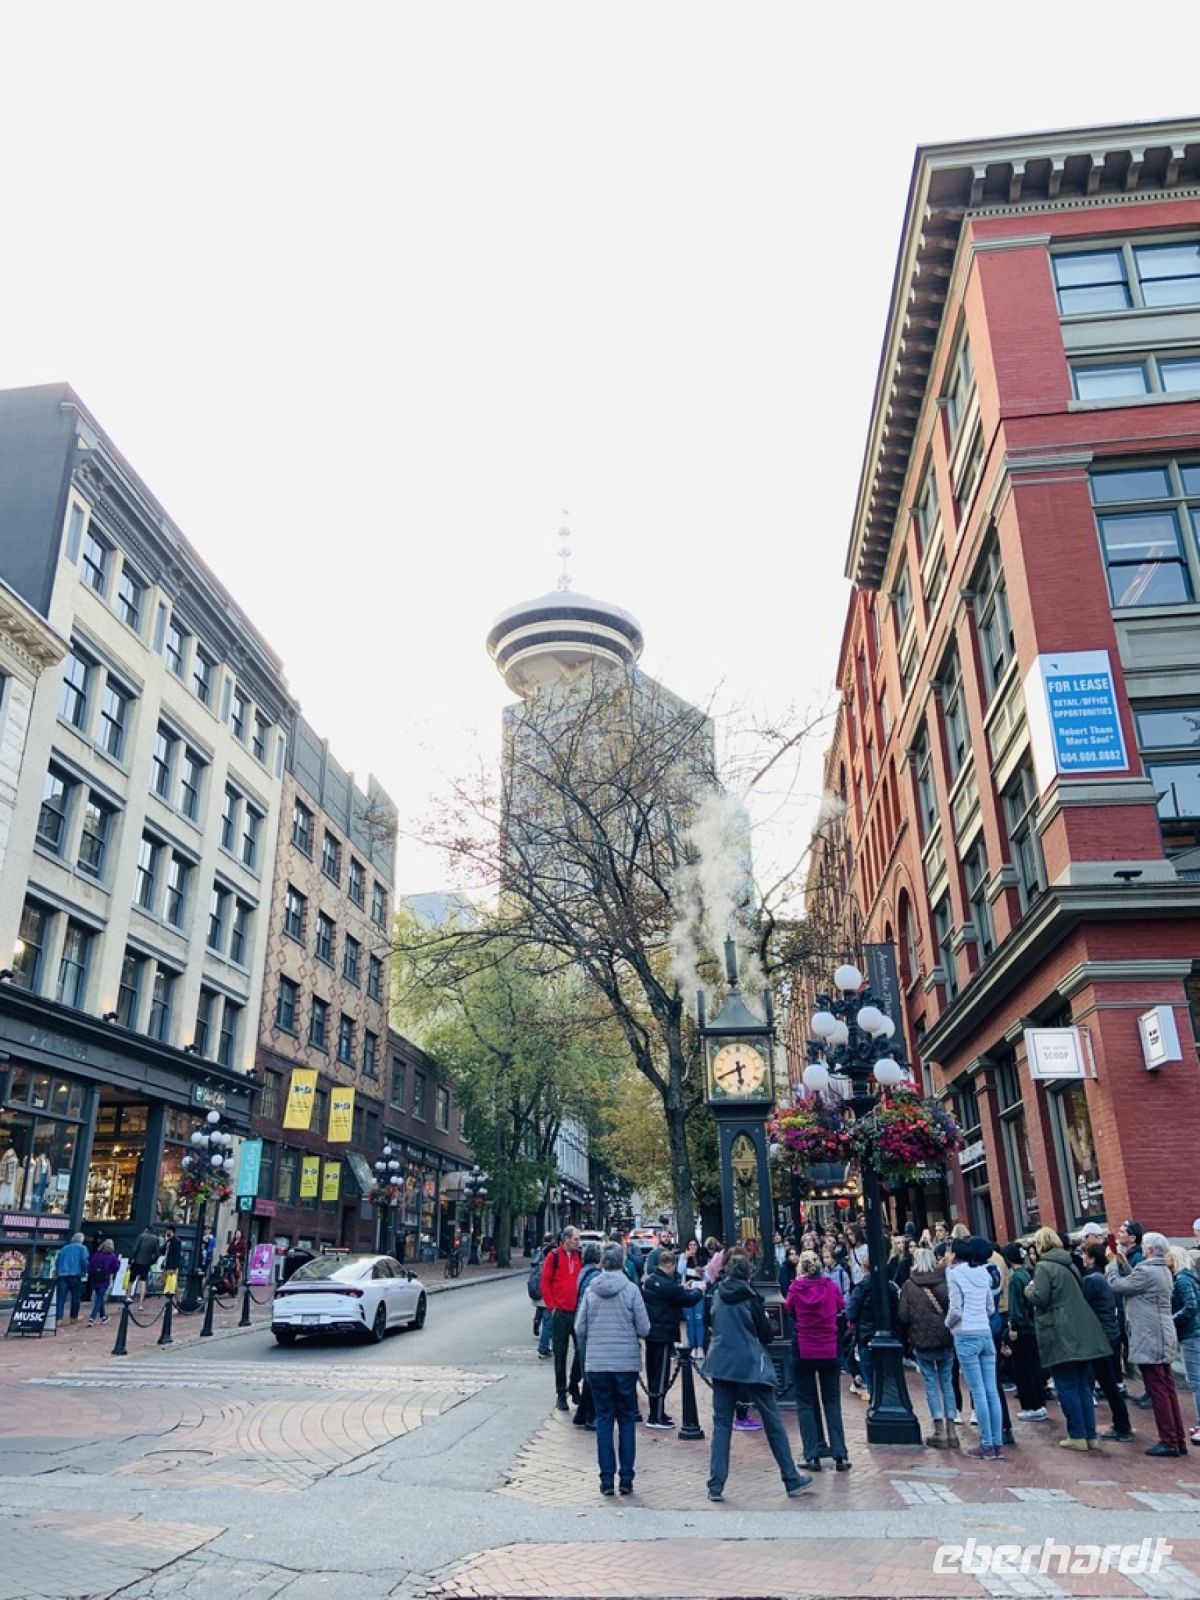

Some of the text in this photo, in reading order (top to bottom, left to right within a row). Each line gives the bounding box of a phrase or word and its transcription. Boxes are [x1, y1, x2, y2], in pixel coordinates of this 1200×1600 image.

[1048, 678, 1110, 693] FOR LEASE
[22, 1300, 43, 1310] LIVE
[14, 1311, 46, 1321] MUSIC
